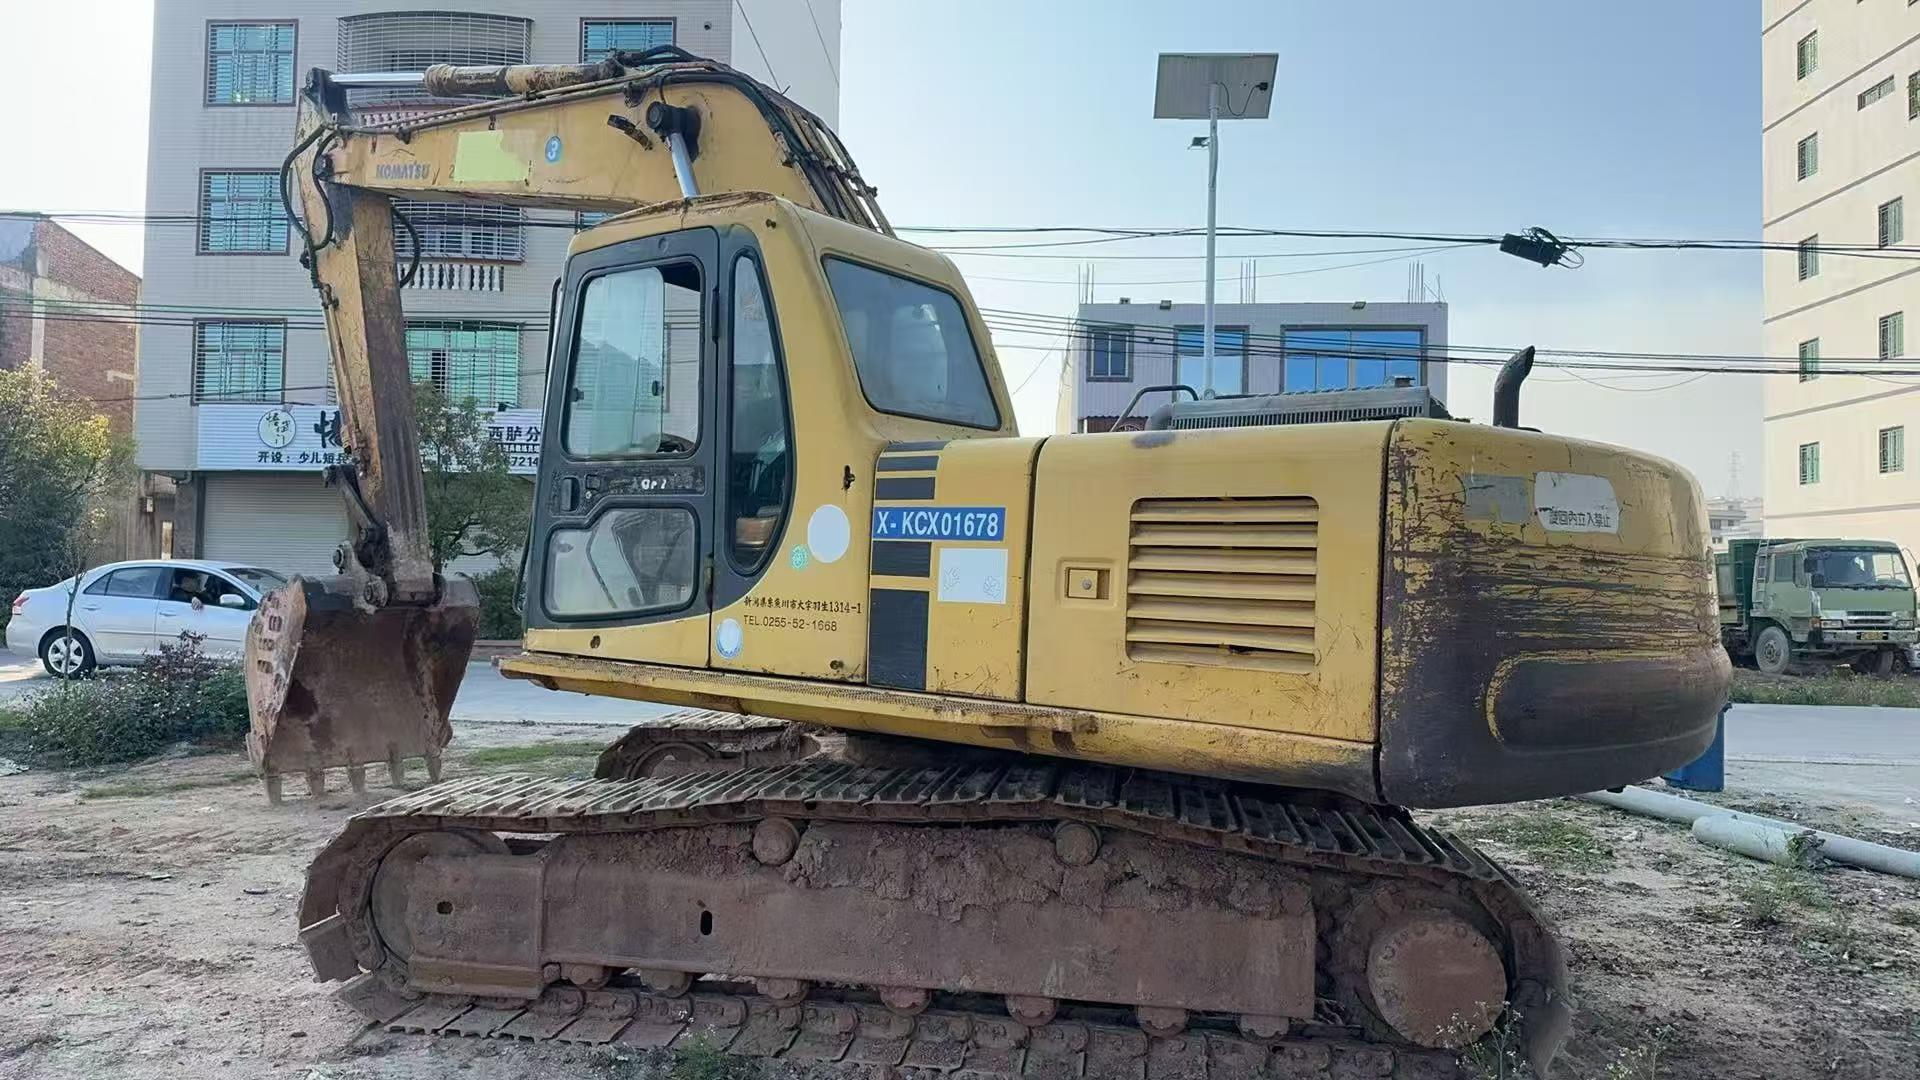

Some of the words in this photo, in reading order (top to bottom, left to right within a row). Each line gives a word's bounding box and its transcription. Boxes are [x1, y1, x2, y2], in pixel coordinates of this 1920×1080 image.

[548, 140, 559, 160] 3
[377, 163, 430, 179] KOMATSU
[743, 614, 837, 632] TEL.0255-52-1668
